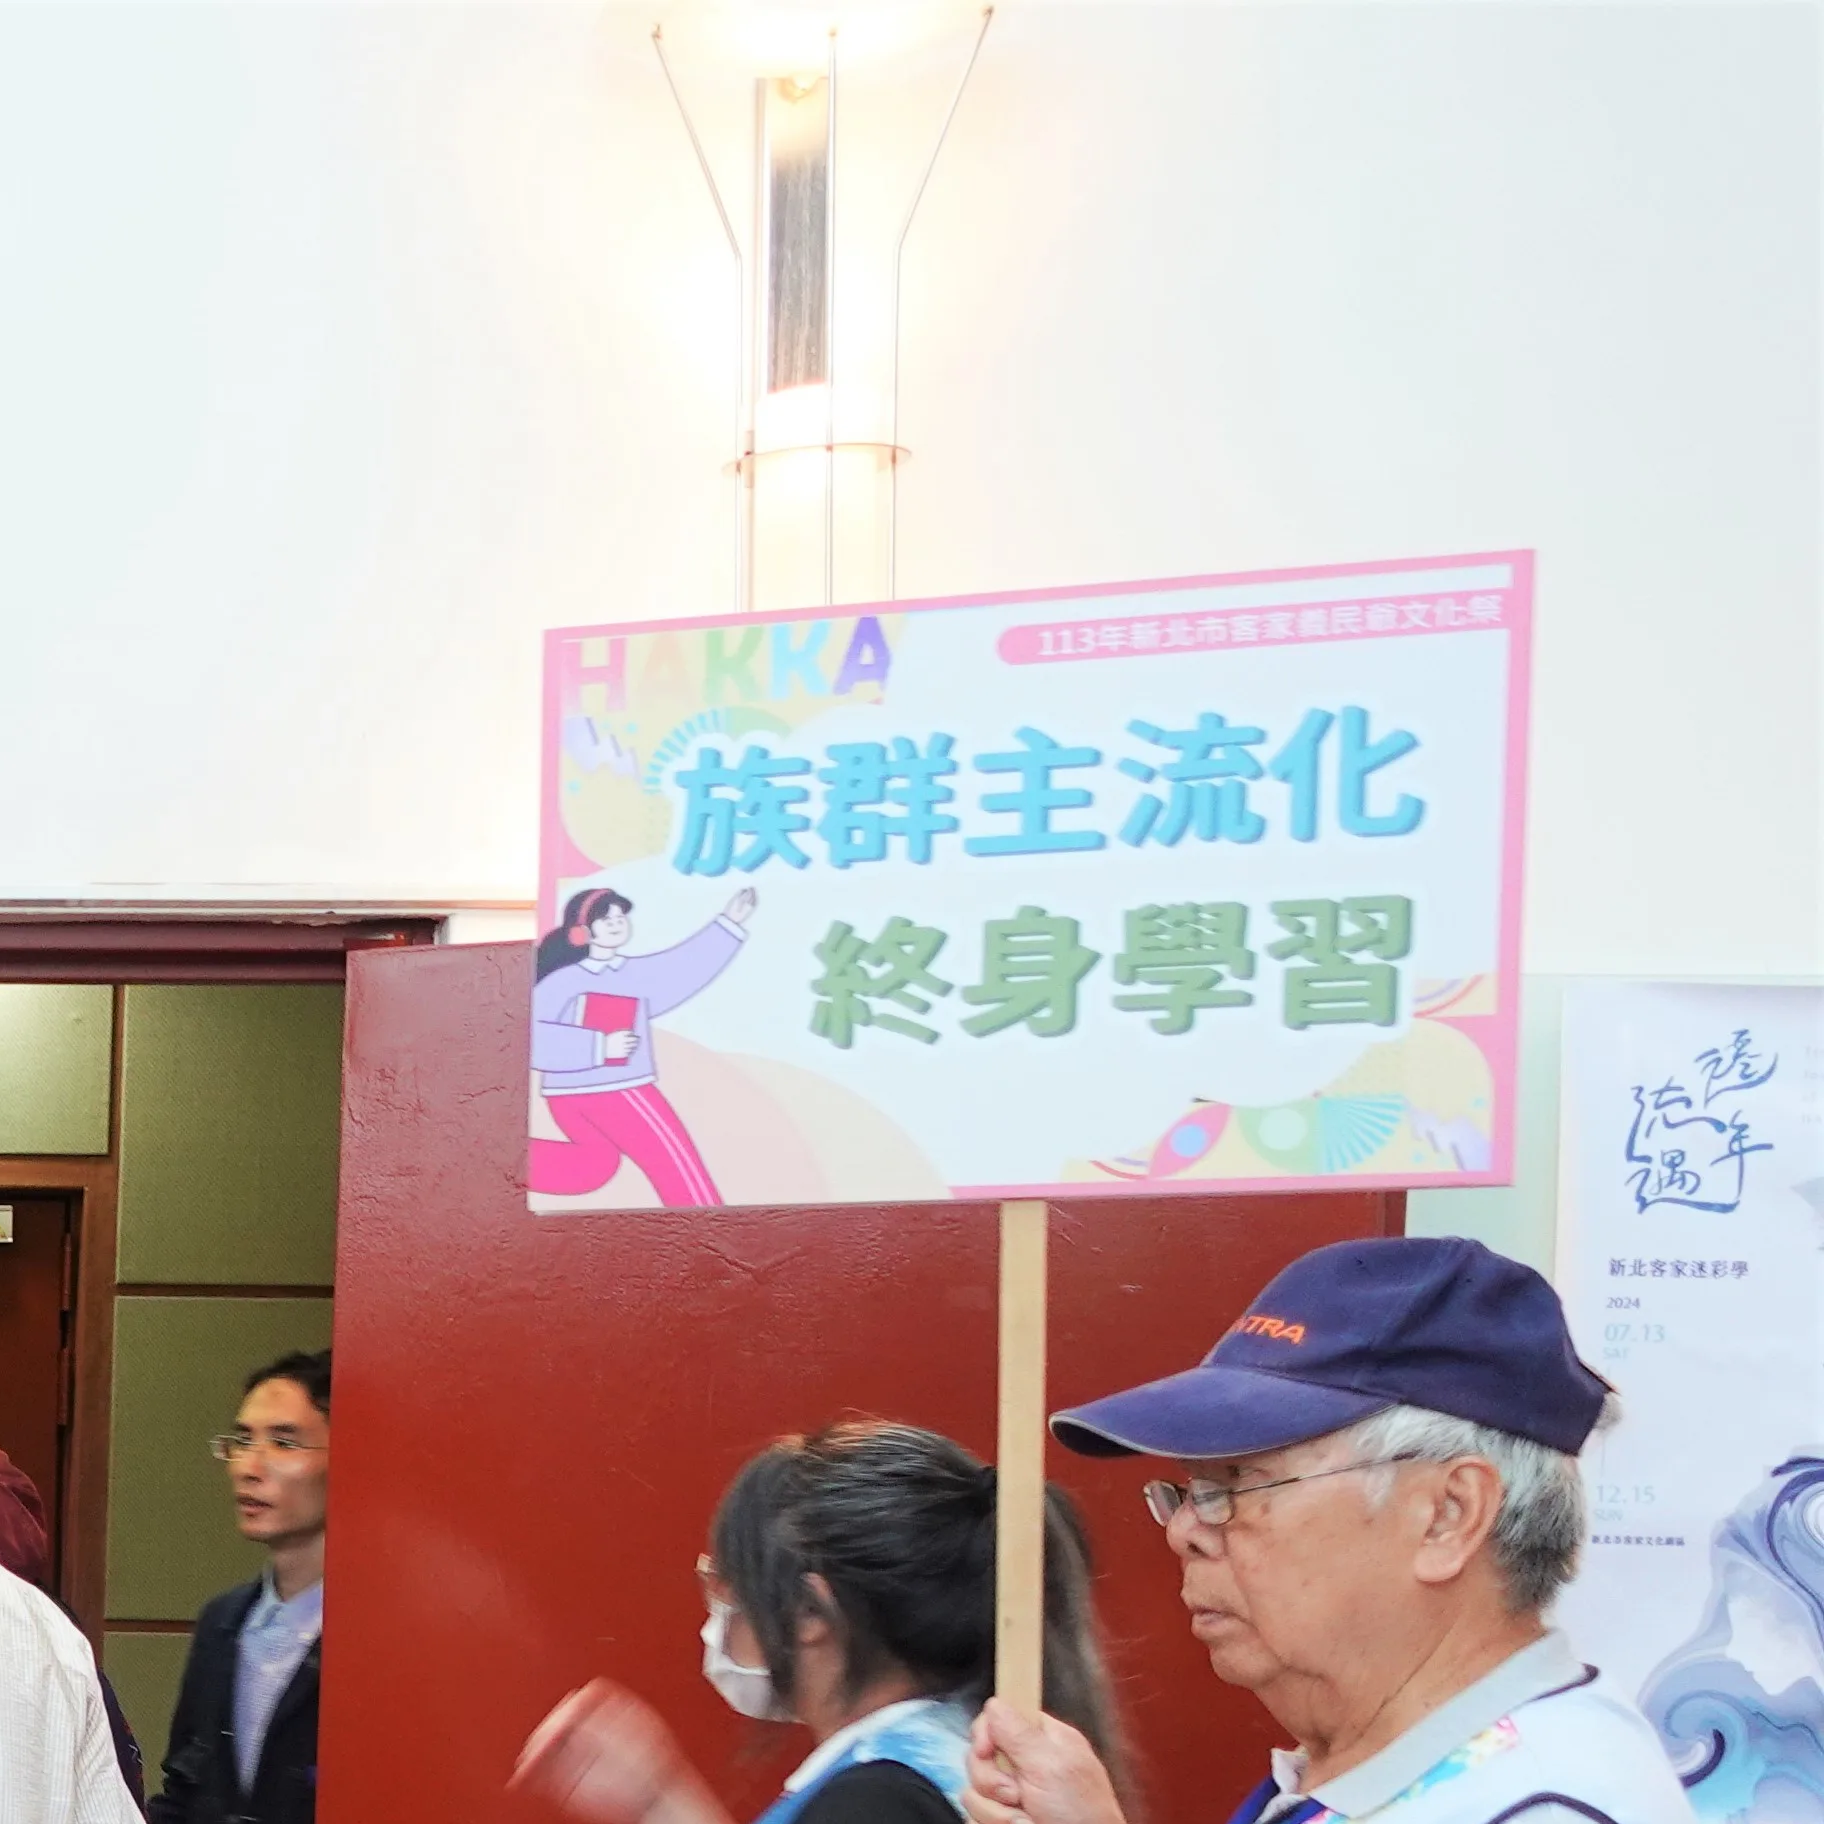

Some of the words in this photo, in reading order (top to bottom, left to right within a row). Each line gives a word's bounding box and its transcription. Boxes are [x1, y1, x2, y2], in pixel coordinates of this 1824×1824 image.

[563, 616, 891, 711] HAKKA
[672, 705, 1426, 877] 族群主流化
[807, 895, 1414, 1050] 終身學習
[1606, 1296, 1641, 1309] 2024
[1234, 1315, 1306, 1345] TRA
[1603, 1323, 1666, 1343] 07.13
[1596, 1484, 1656, 1504] 12.15
